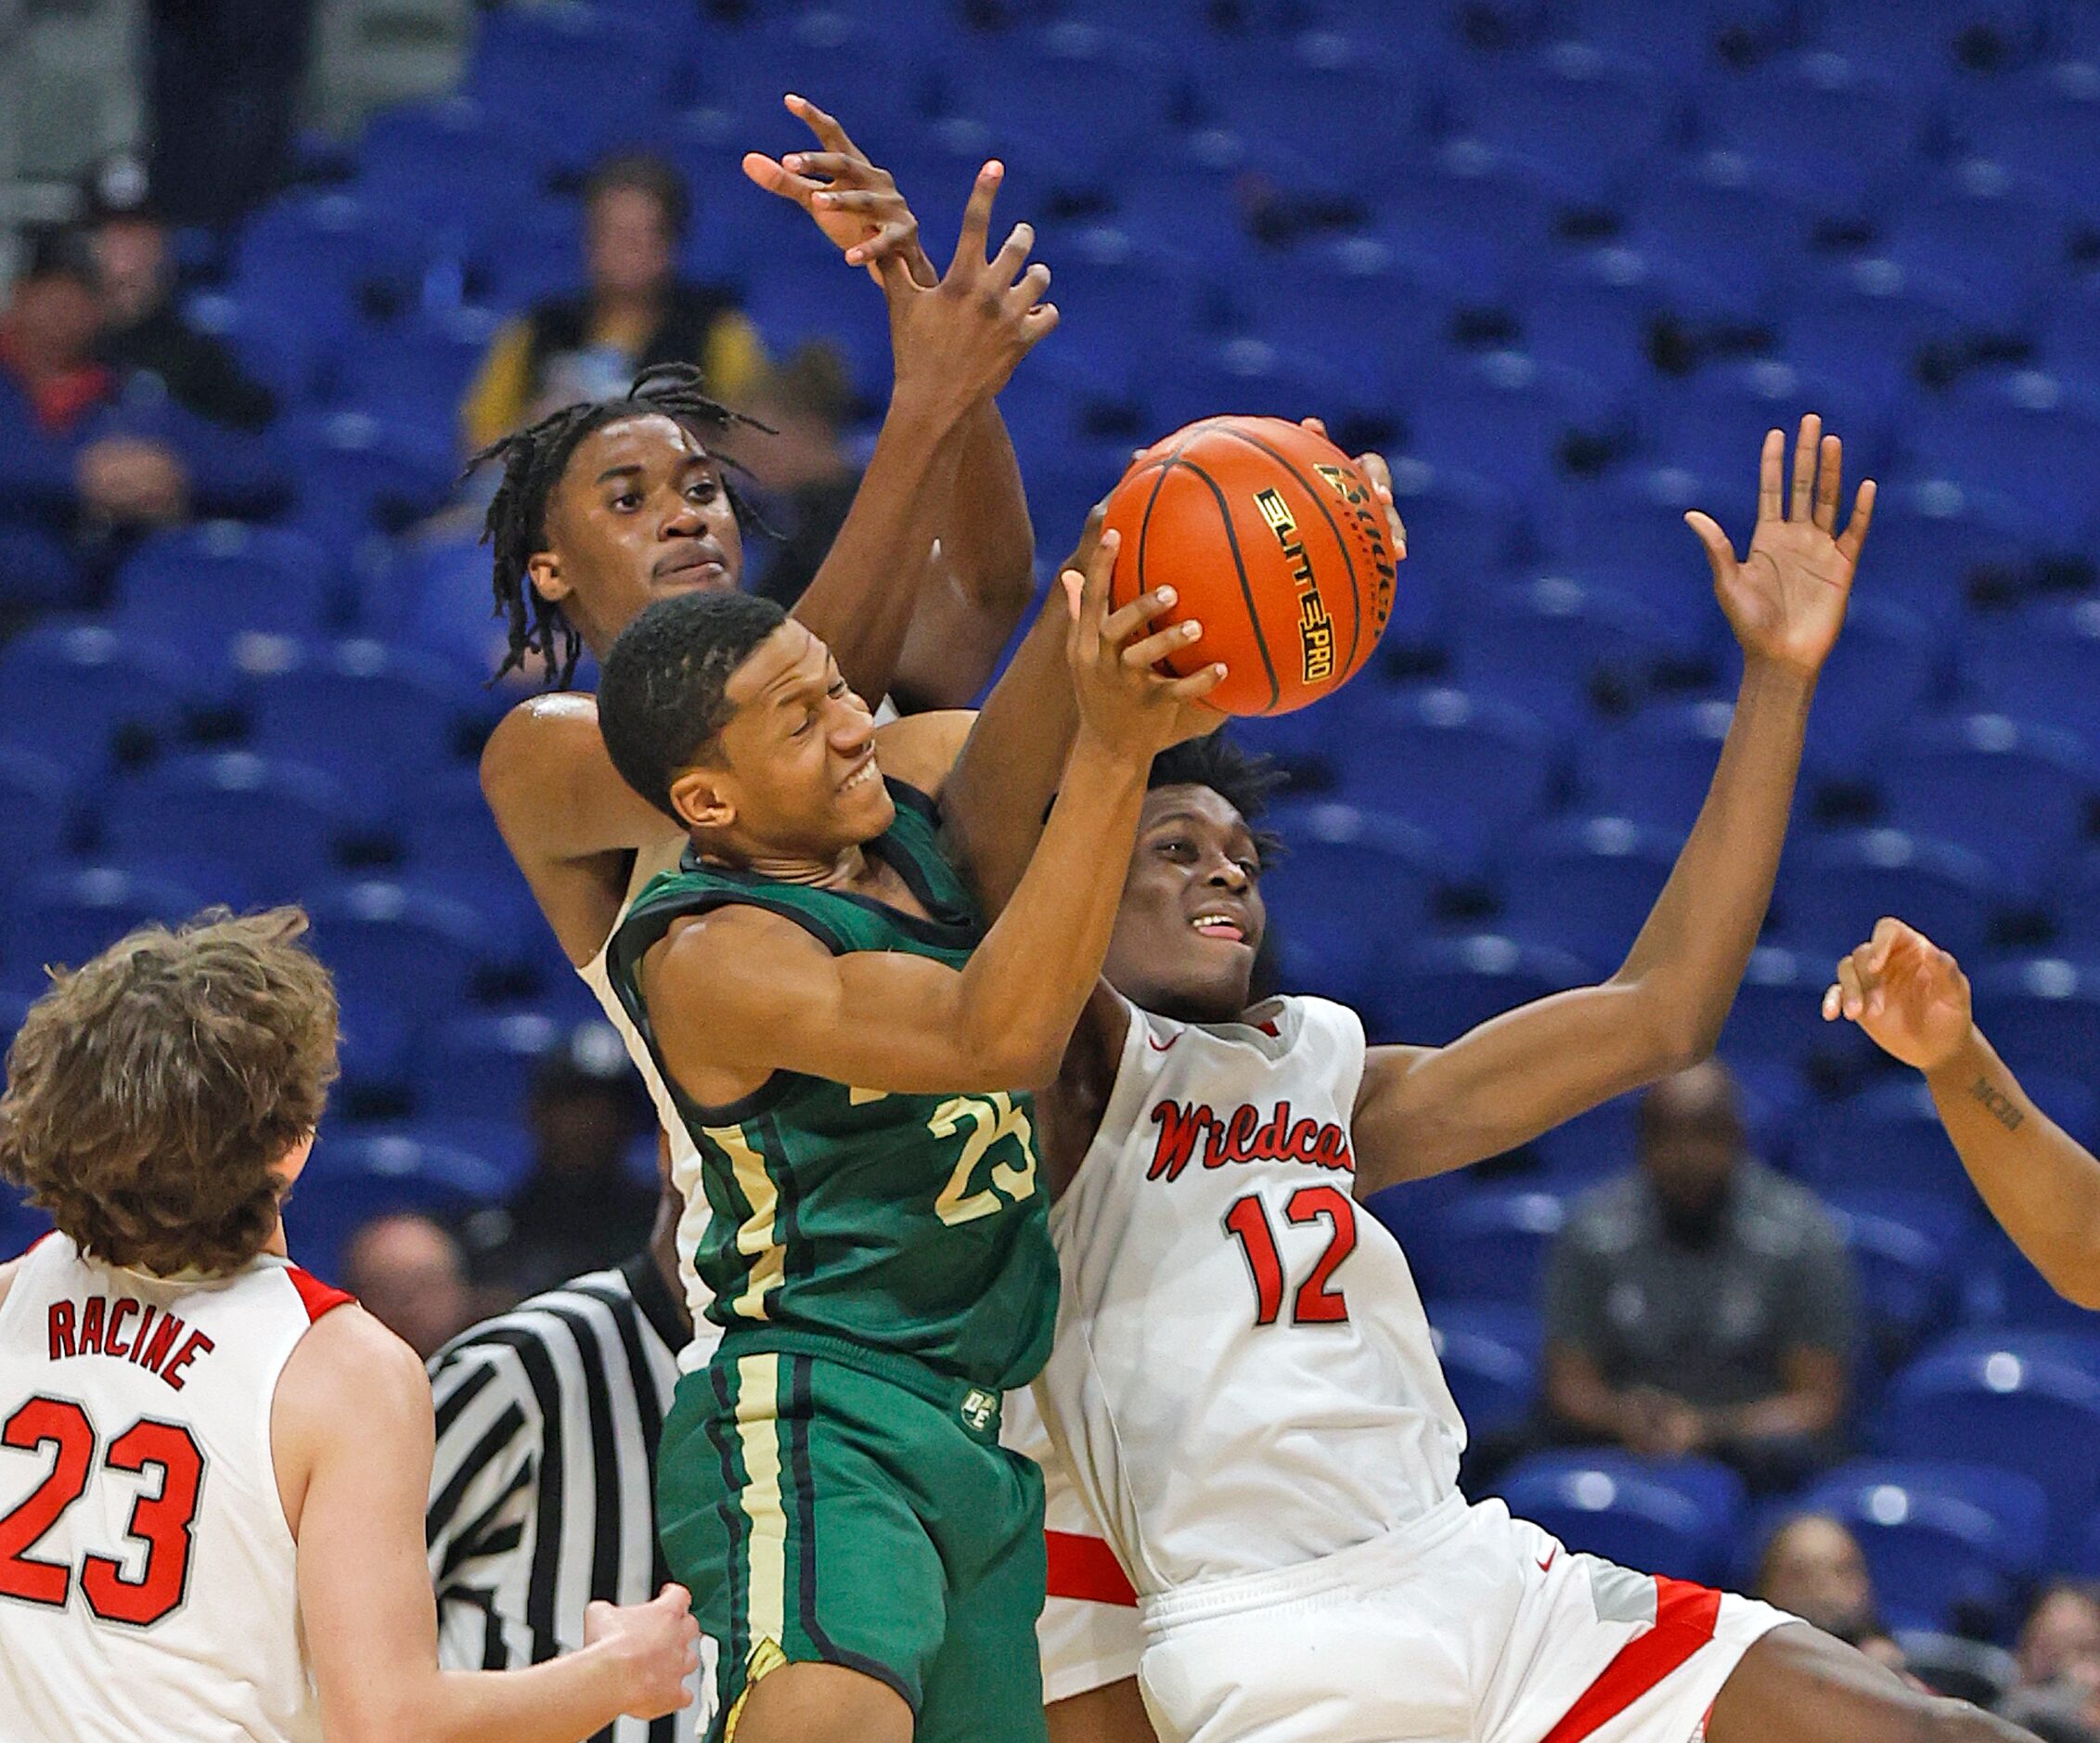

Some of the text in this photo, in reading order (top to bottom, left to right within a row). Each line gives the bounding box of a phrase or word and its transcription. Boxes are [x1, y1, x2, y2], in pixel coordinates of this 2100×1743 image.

[1253, 487, 1336, 683] ELITE PRO
[927, 1091, 1037, 1226] 25
[1221, 1182, 1358, 1327] 12
[47, 1296, 215, 1391] RACINE
[0, 1394, 207, 1629] 23
